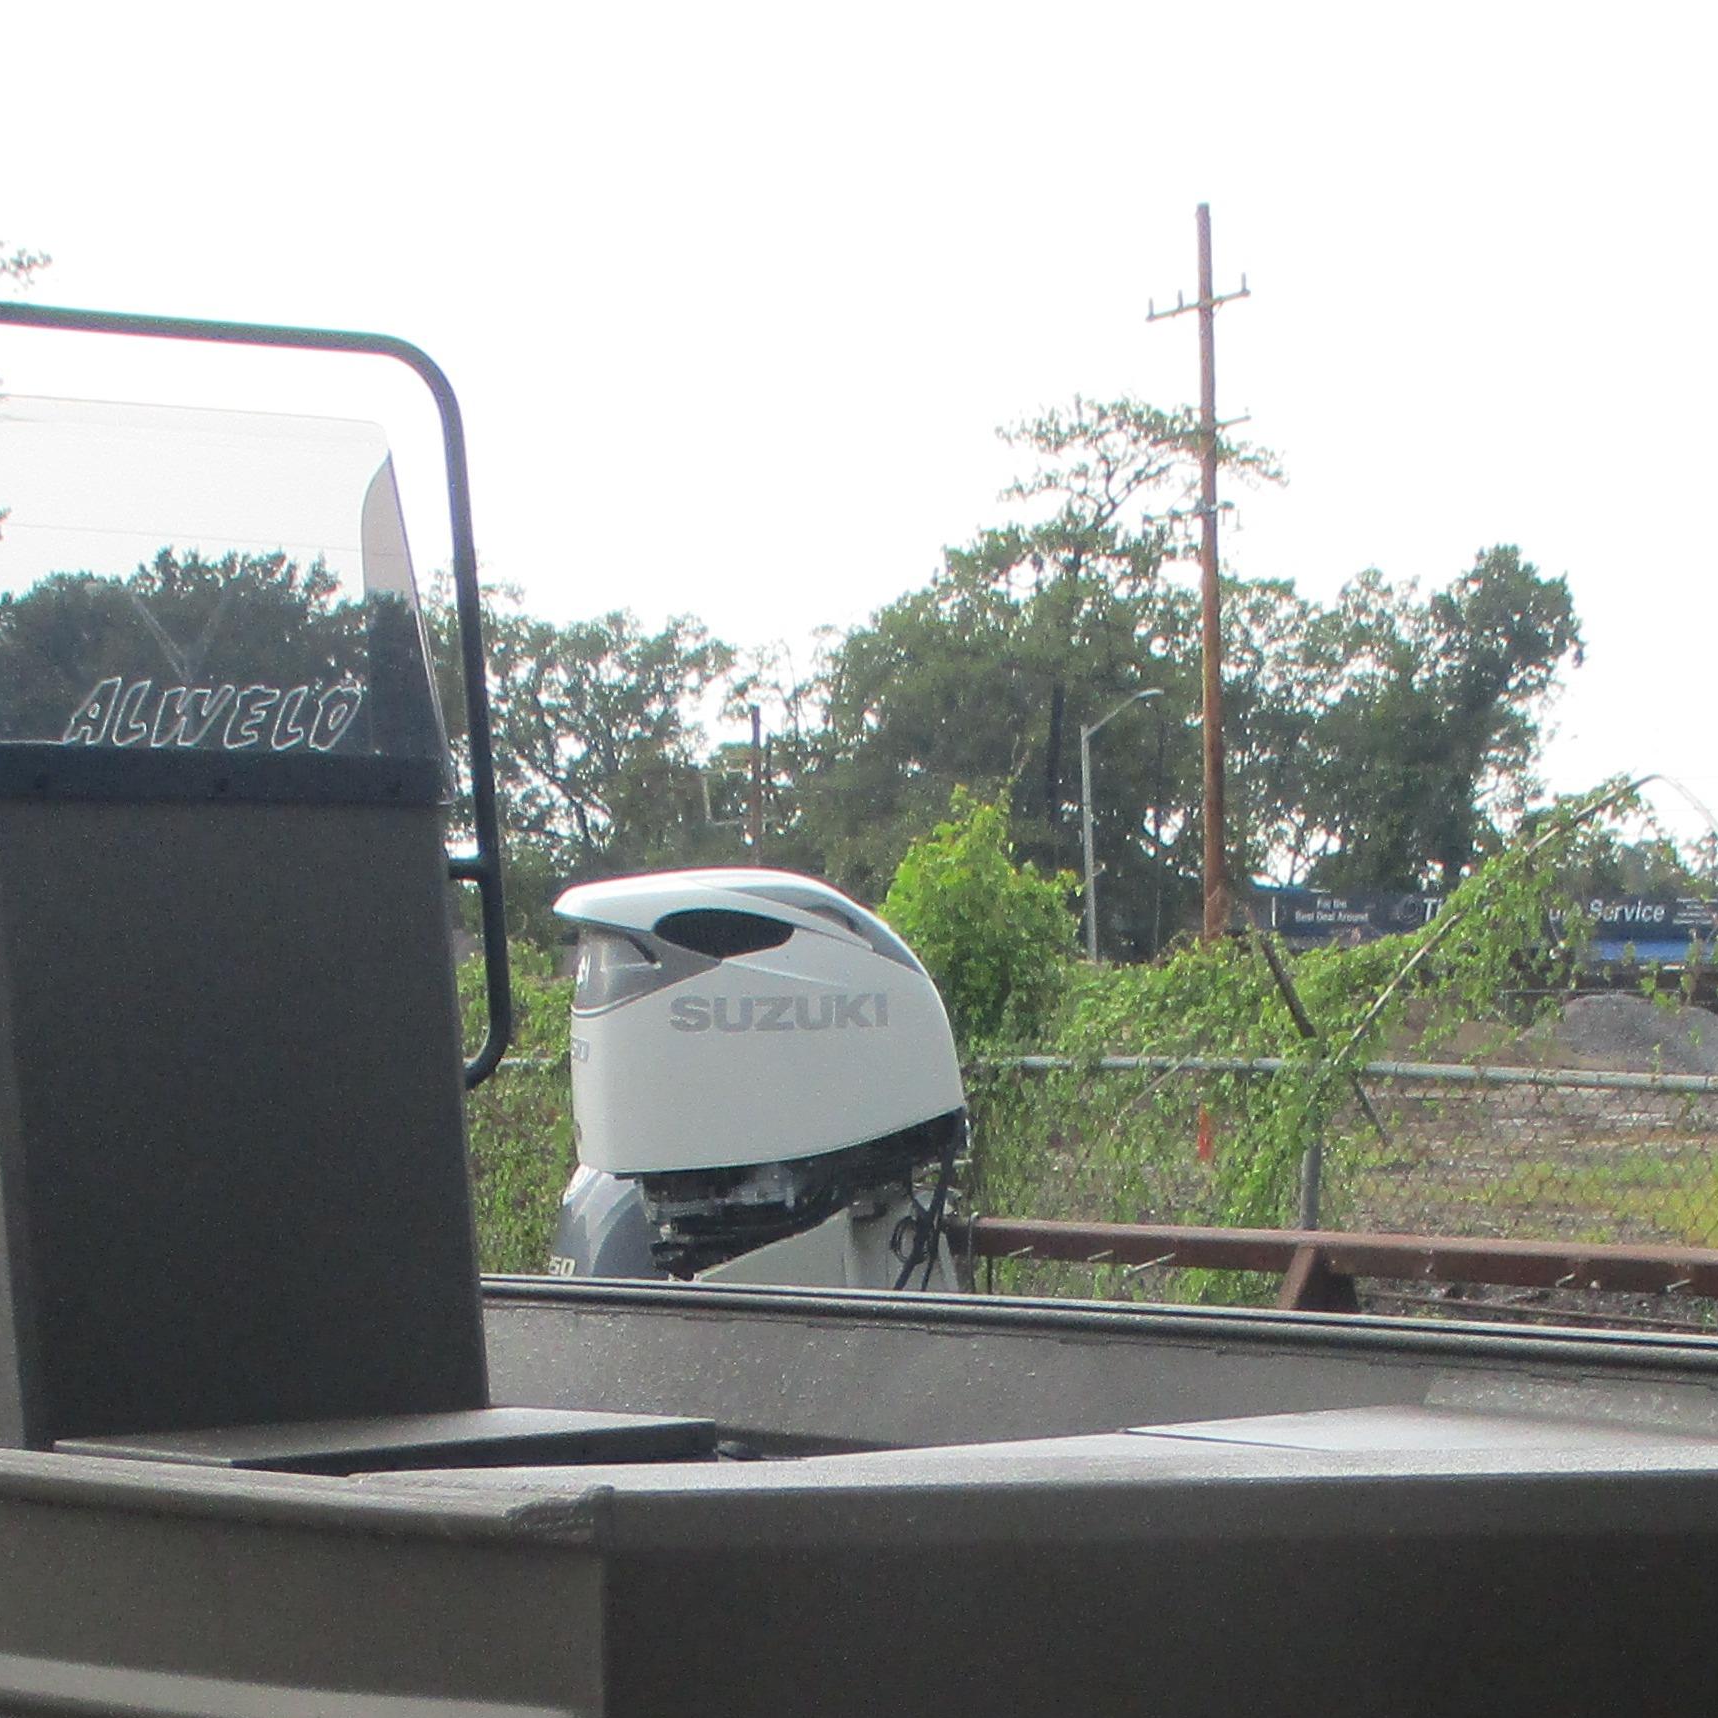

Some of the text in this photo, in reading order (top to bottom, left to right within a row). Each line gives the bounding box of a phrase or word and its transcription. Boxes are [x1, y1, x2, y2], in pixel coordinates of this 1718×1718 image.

[63, 677, 362, 750] ALWELD
[1336, 911, 1369, 923] Around
[1588, 899, 1666, 924] Service
[668, 993, 889, 1033] SUZUKI
